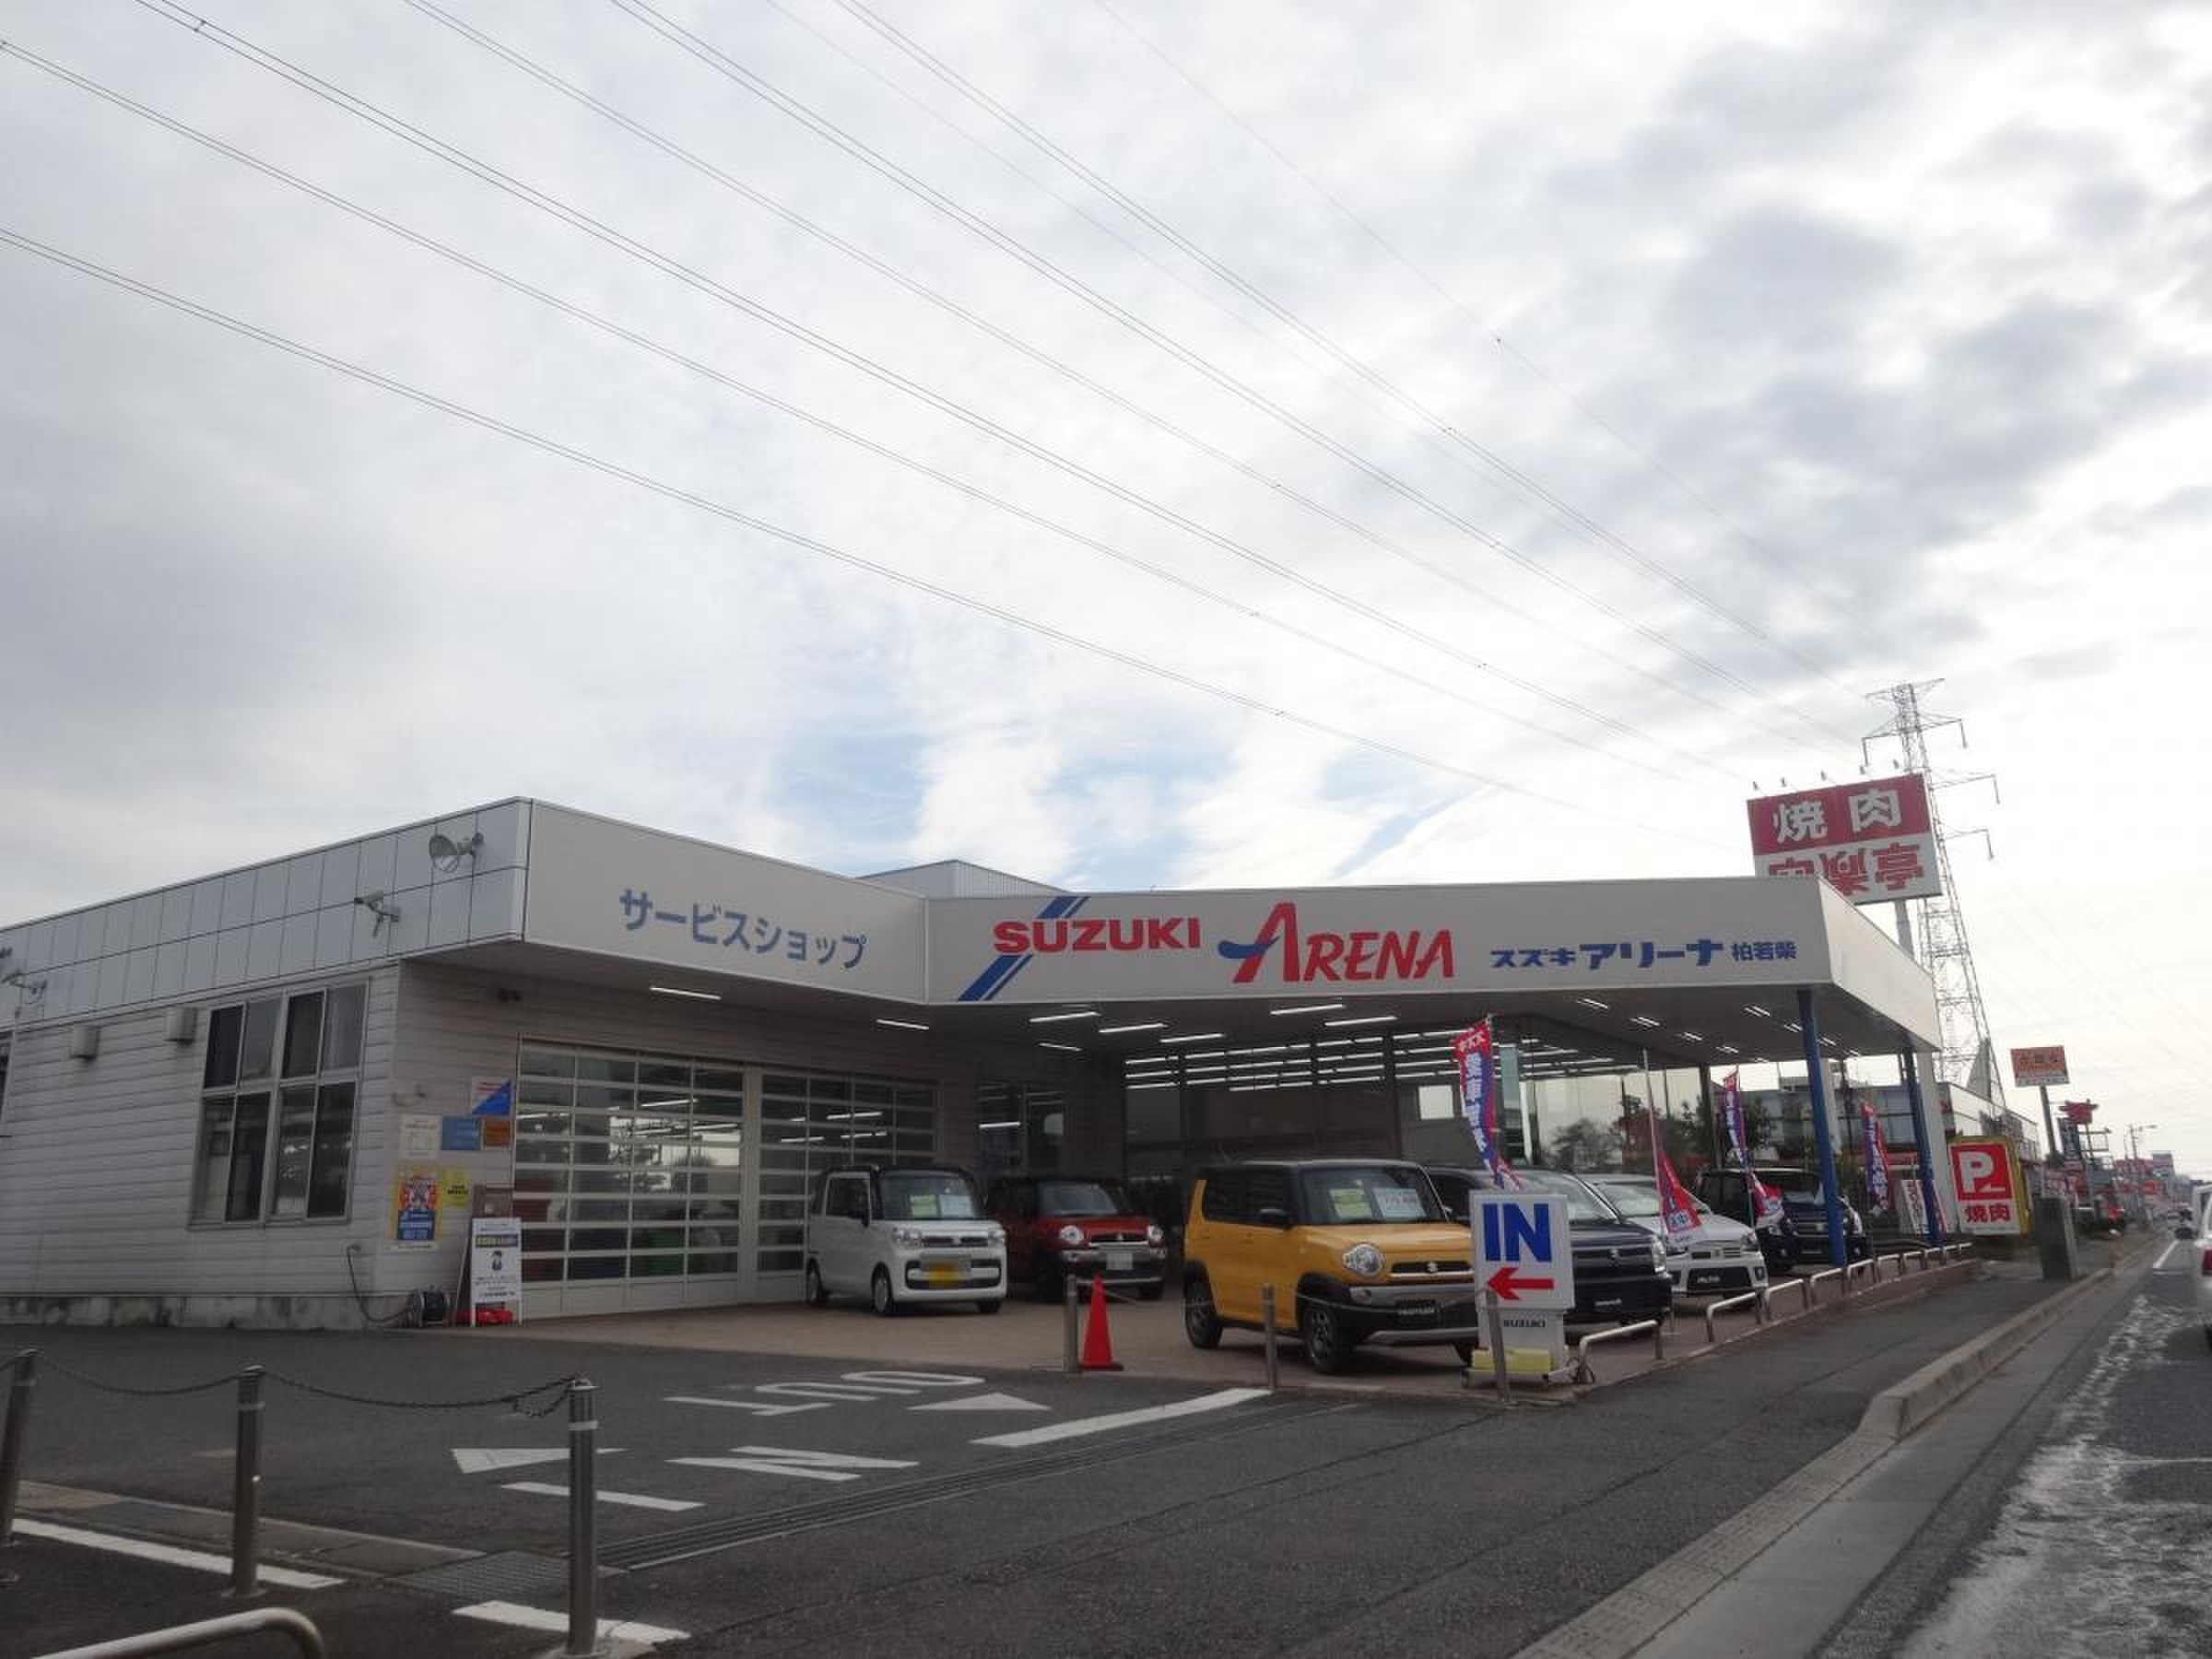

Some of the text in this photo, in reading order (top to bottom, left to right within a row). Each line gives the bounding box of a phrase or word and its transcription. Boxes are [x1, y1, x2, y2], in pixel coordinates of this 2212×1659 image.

[1771, 788, 1902, 843] 焼肉
[619, 888, 867, 970] サービスショップ
[993, 901, 1453, 983] SUZUKI ARENA
[1958, 1150, 1994, 1194] P
[1481, 1202, 1553, 1264] IN
[1964, 1205, 2010, 1223] 焼肉
